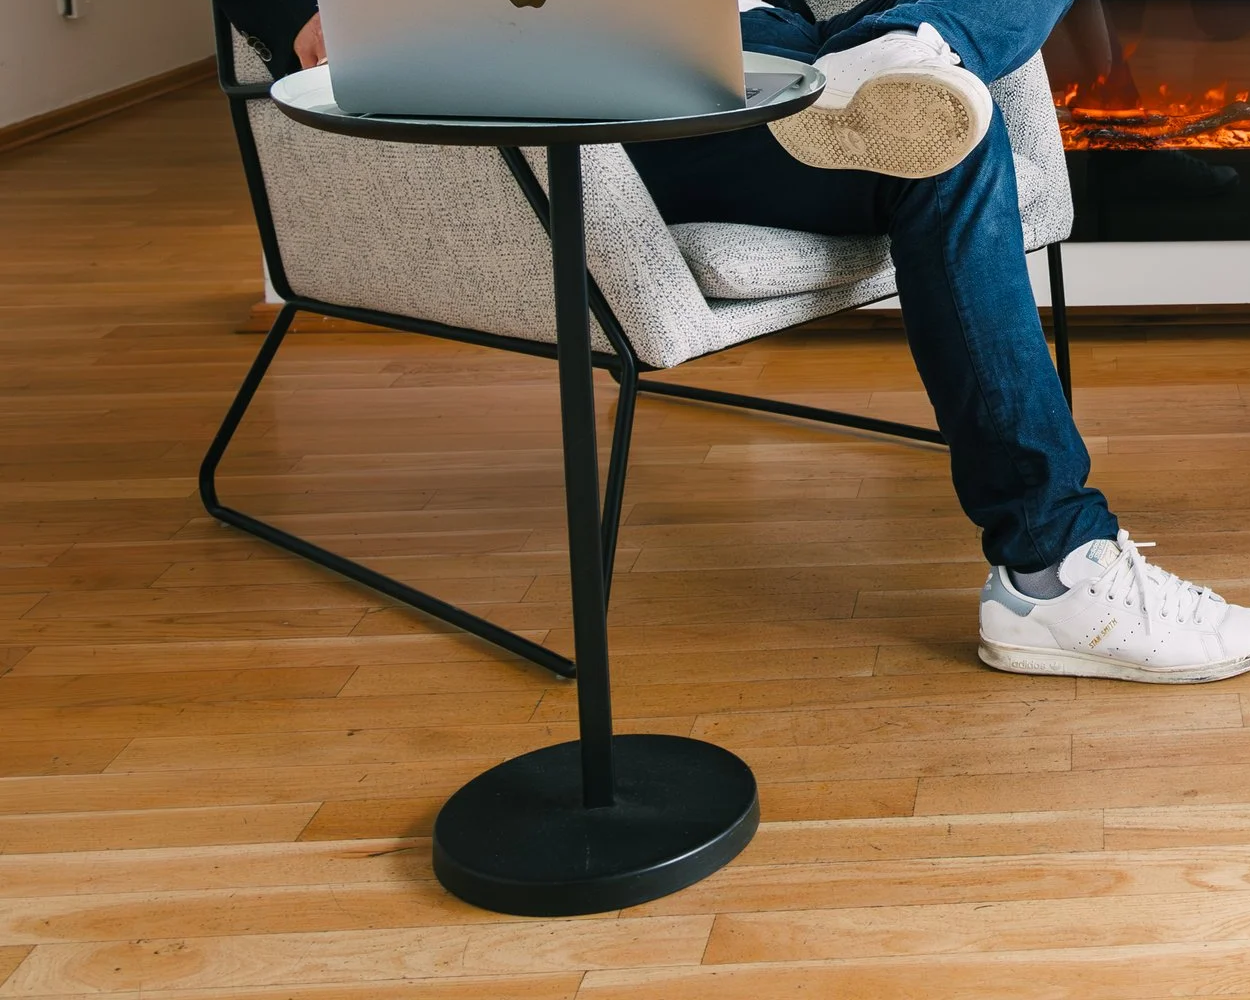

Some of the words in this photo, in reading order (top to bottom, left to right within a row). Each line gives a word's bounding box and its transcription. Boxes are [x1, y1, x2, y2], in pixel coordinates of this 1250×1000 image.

[1088, 634, 1102, 649] STAN
[1101, 617, 1118, 636] SMITH
[1011, 660, 1046, 670] adidas
